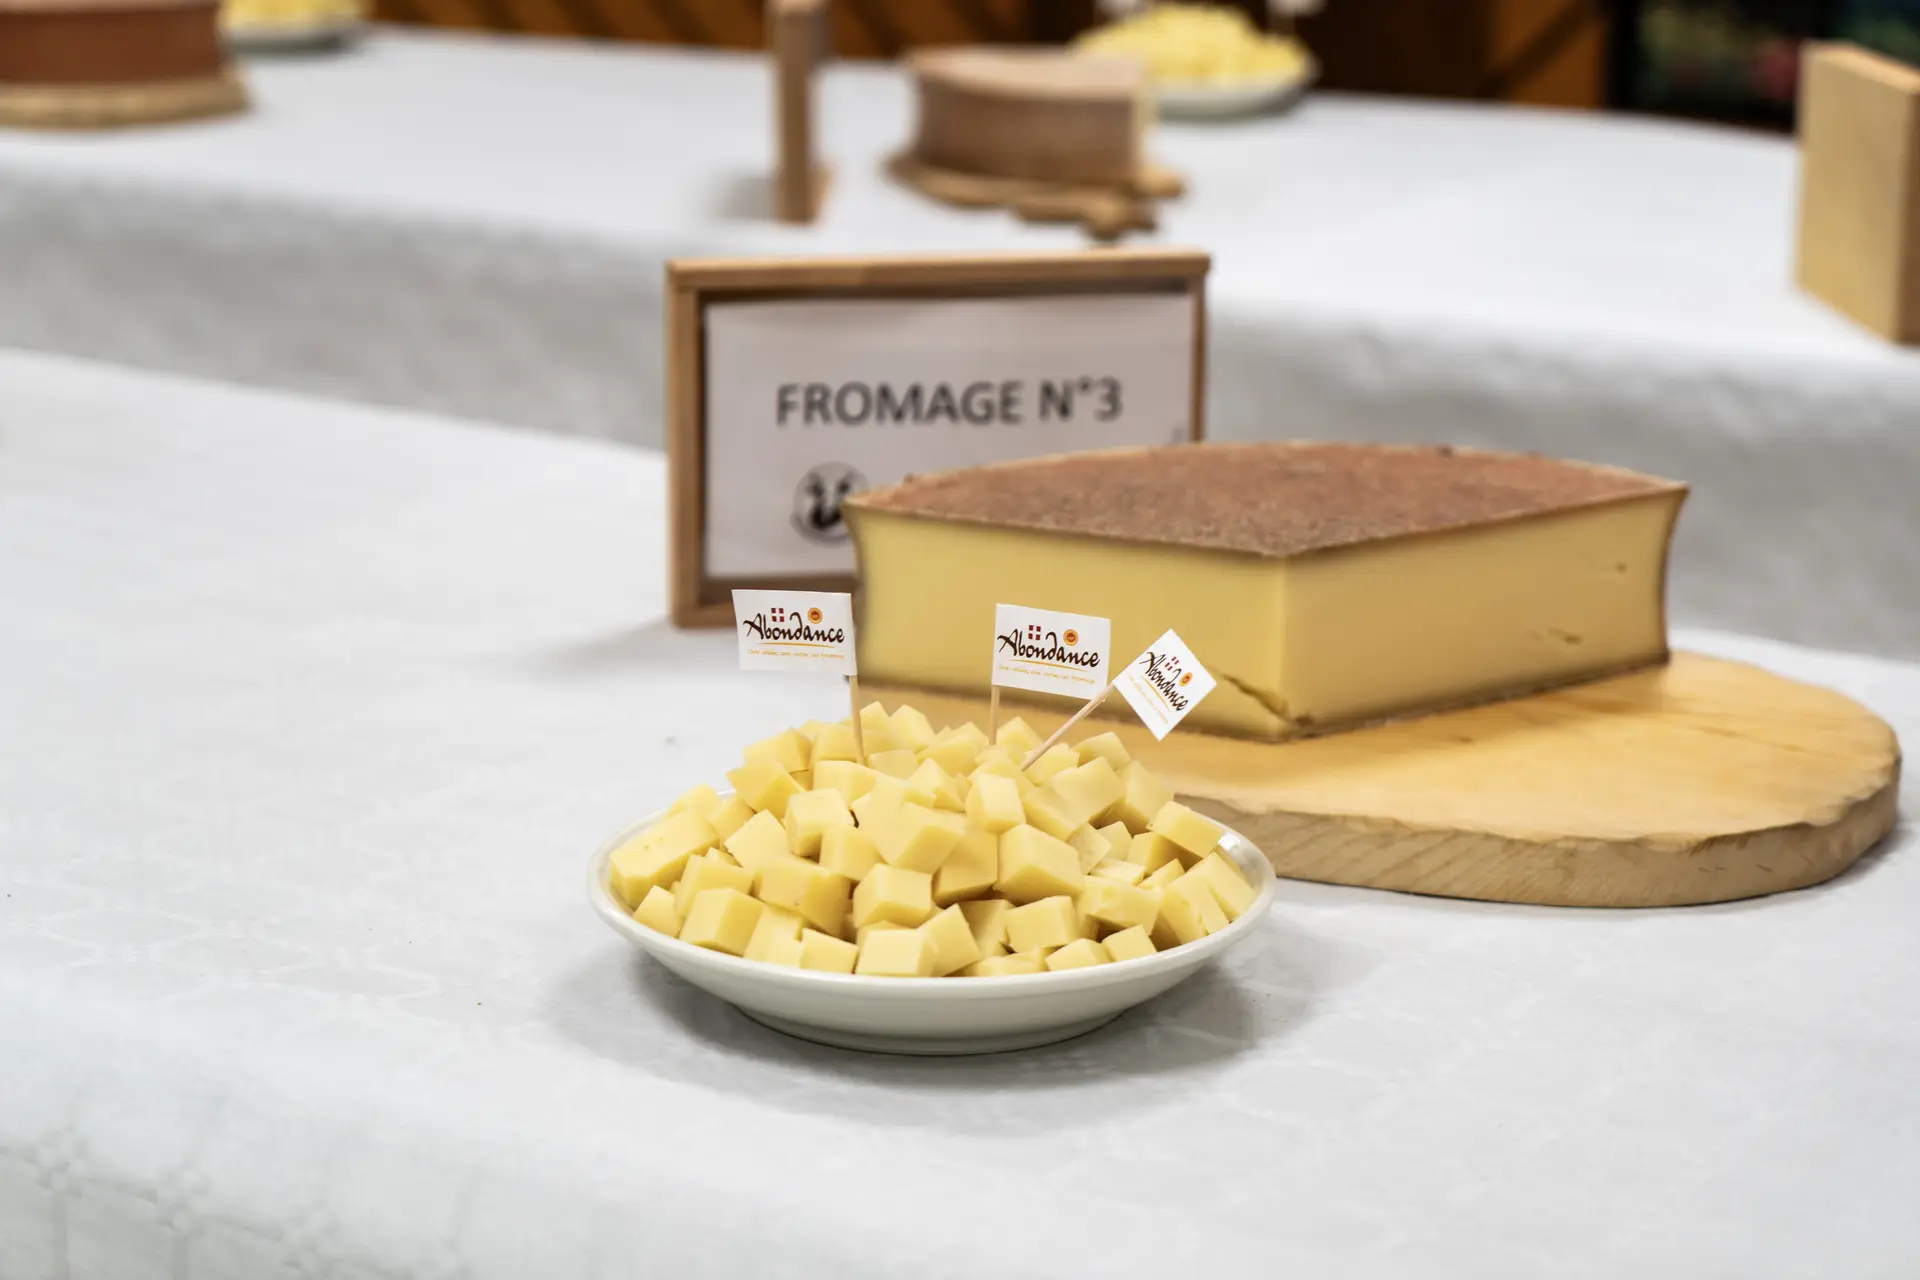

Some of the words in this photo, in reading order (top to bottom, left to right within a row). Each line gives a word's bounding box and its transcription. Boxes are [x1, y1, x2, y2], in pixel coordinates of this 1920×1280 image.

[776, 379, 1025, 426] FROMAGE
[1038, 376, 1123, 423] N°3
[743, 612, 845, 643] Abondance
[997, 628, 1100, 667] Abondance
[1139, 651, 1189, 711] Abondance
